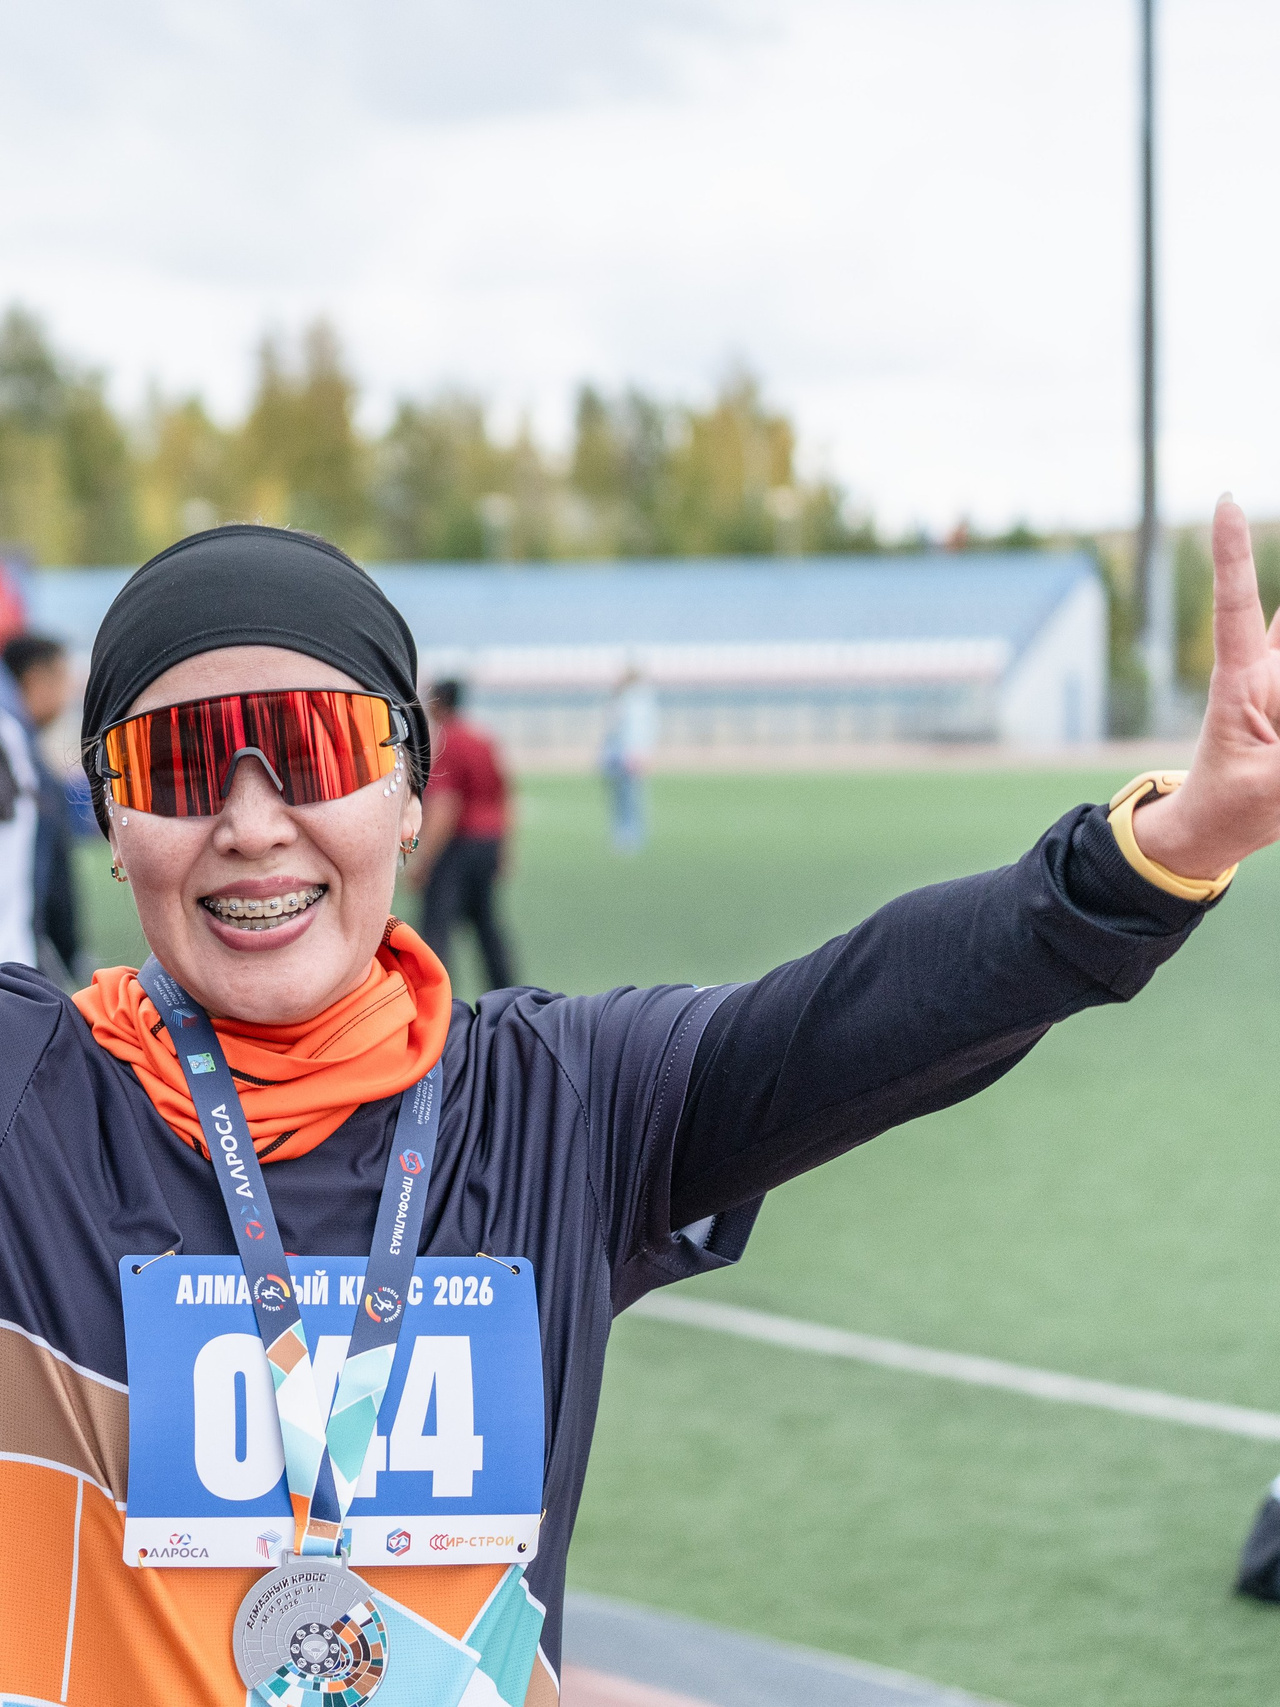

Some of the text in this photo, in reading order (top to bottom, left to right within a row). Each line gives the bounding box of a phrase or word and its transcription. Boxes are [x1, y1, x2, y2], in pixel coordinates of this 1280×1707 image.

[211, 1103, 254, 1199] АЛРОСА
[389, 1176, 414, 1256] ПРОФАЛМАЗ
[175, 1269, 329, 1305] АЛМАЫЙ
[433, 1276, 494, 1306] 2026
[246, 1572, 327, 1630] АЛМАЗНЫЙ КРОСС
[261, 1584, 314, 1624] МИРНЫЙ
[279, 1598, 300, 1614] 2026
